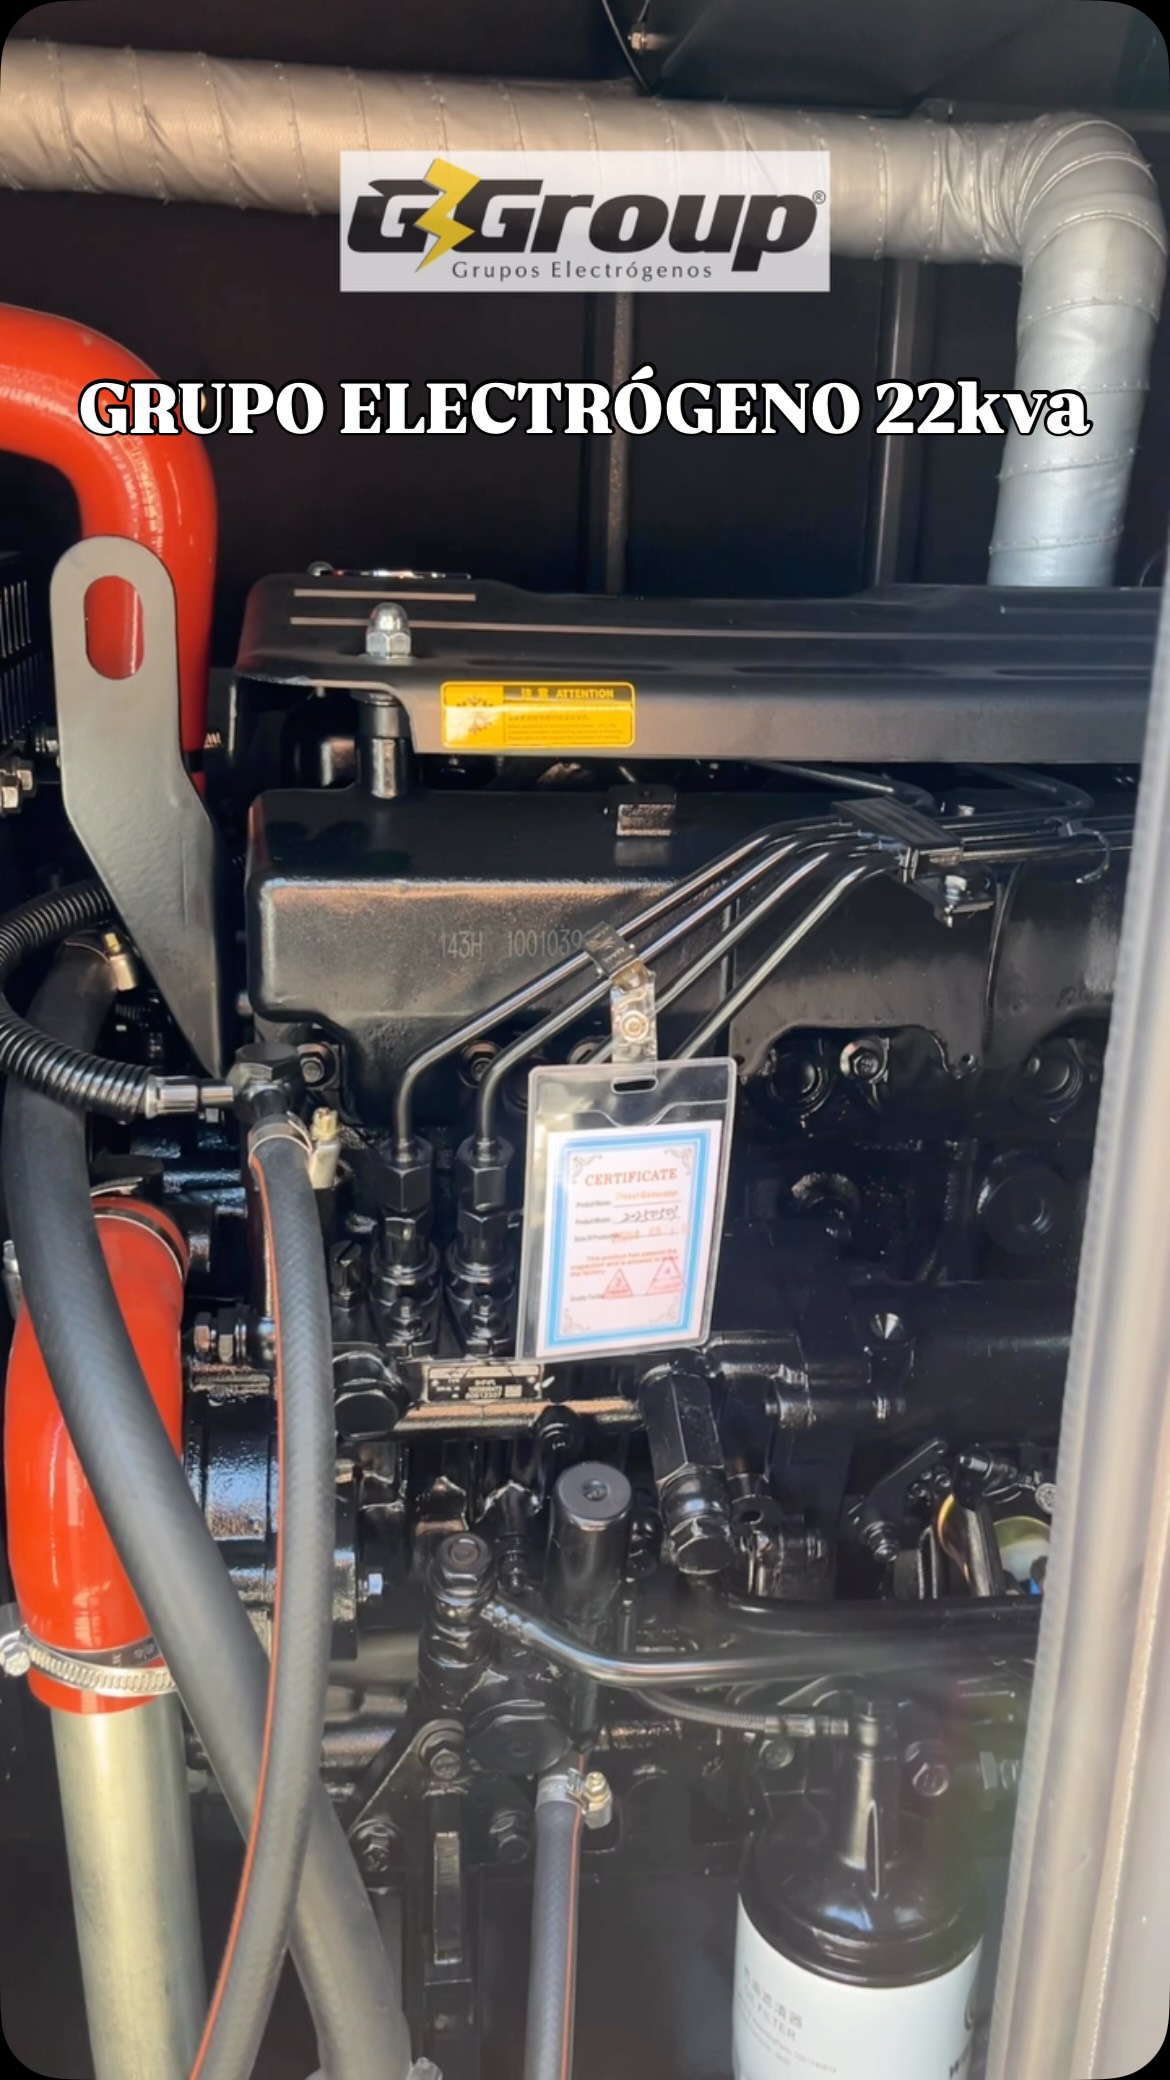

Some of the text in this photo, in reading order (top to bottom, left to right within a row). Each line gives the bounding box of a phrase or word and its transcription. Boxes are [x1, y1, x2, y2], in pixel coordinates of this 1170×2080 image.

[556, 688, 614, 699] ATTENTION
[439, 930, 483, 958] 143H
[584, 1167, 679, 1187] CERTIFICATE
